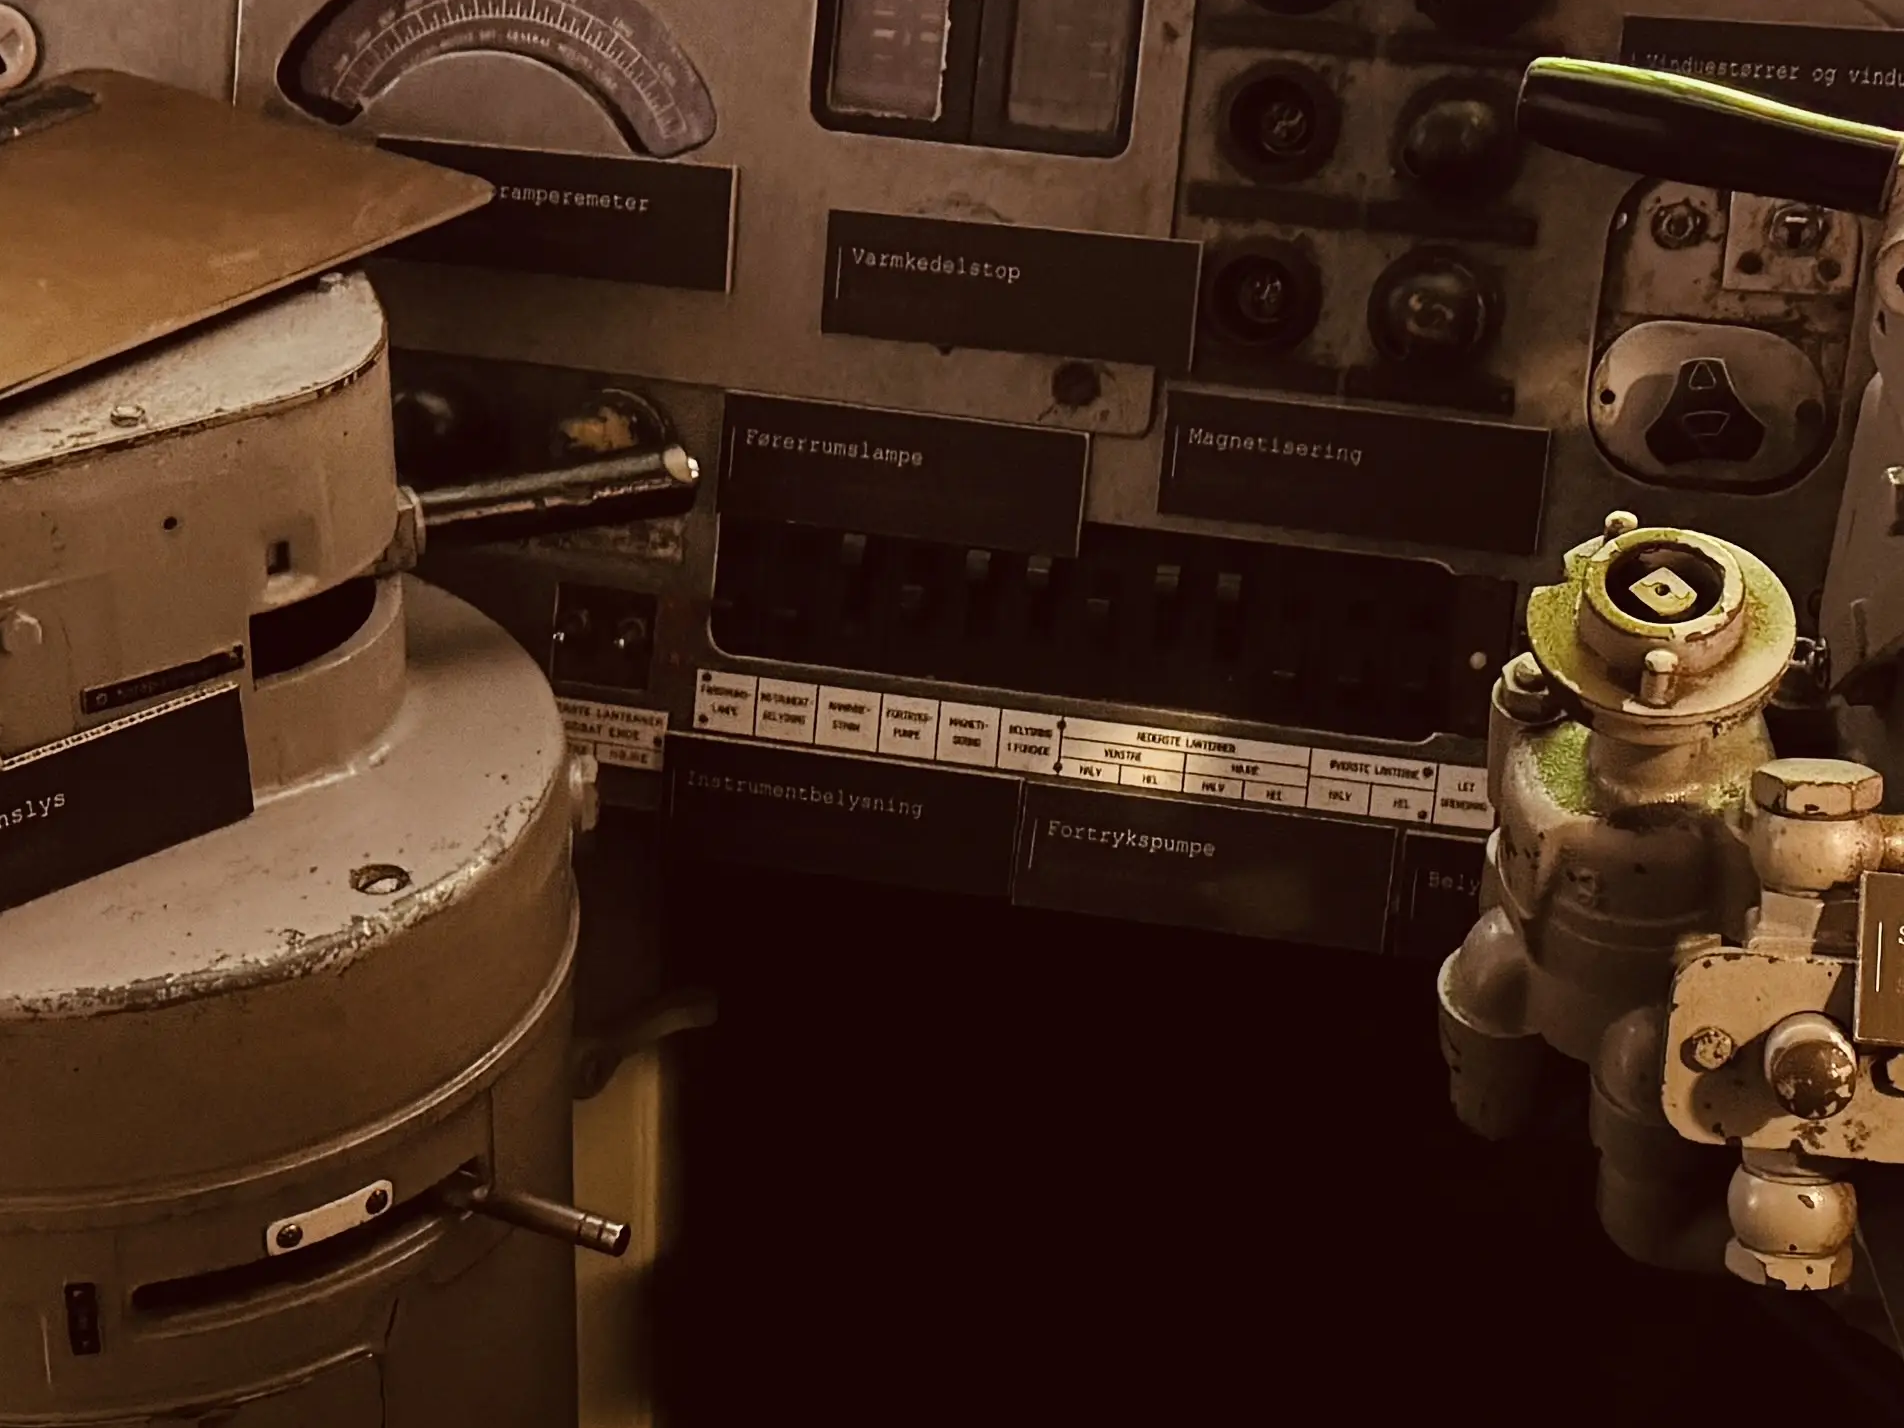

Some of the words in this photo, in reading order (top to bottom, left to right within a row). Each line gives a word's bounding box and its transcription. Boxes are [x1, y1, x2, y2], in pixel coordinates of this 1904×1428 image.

[1811, 66, 1838, 87] og
[500, 185, 650, 212] ramperemeter
[852, 247, 1022, 284] Varmkedelstop
[744, 426, 925, 469] Førerrumslampe
[1188, 423, 1364, 465] Magnetisering
[686, 769, 926, 820] Instrumentbelysning
[1045, 818, 1217, 860] Fortrykspumpe
[1427, 869, 1481, 897] Bely
